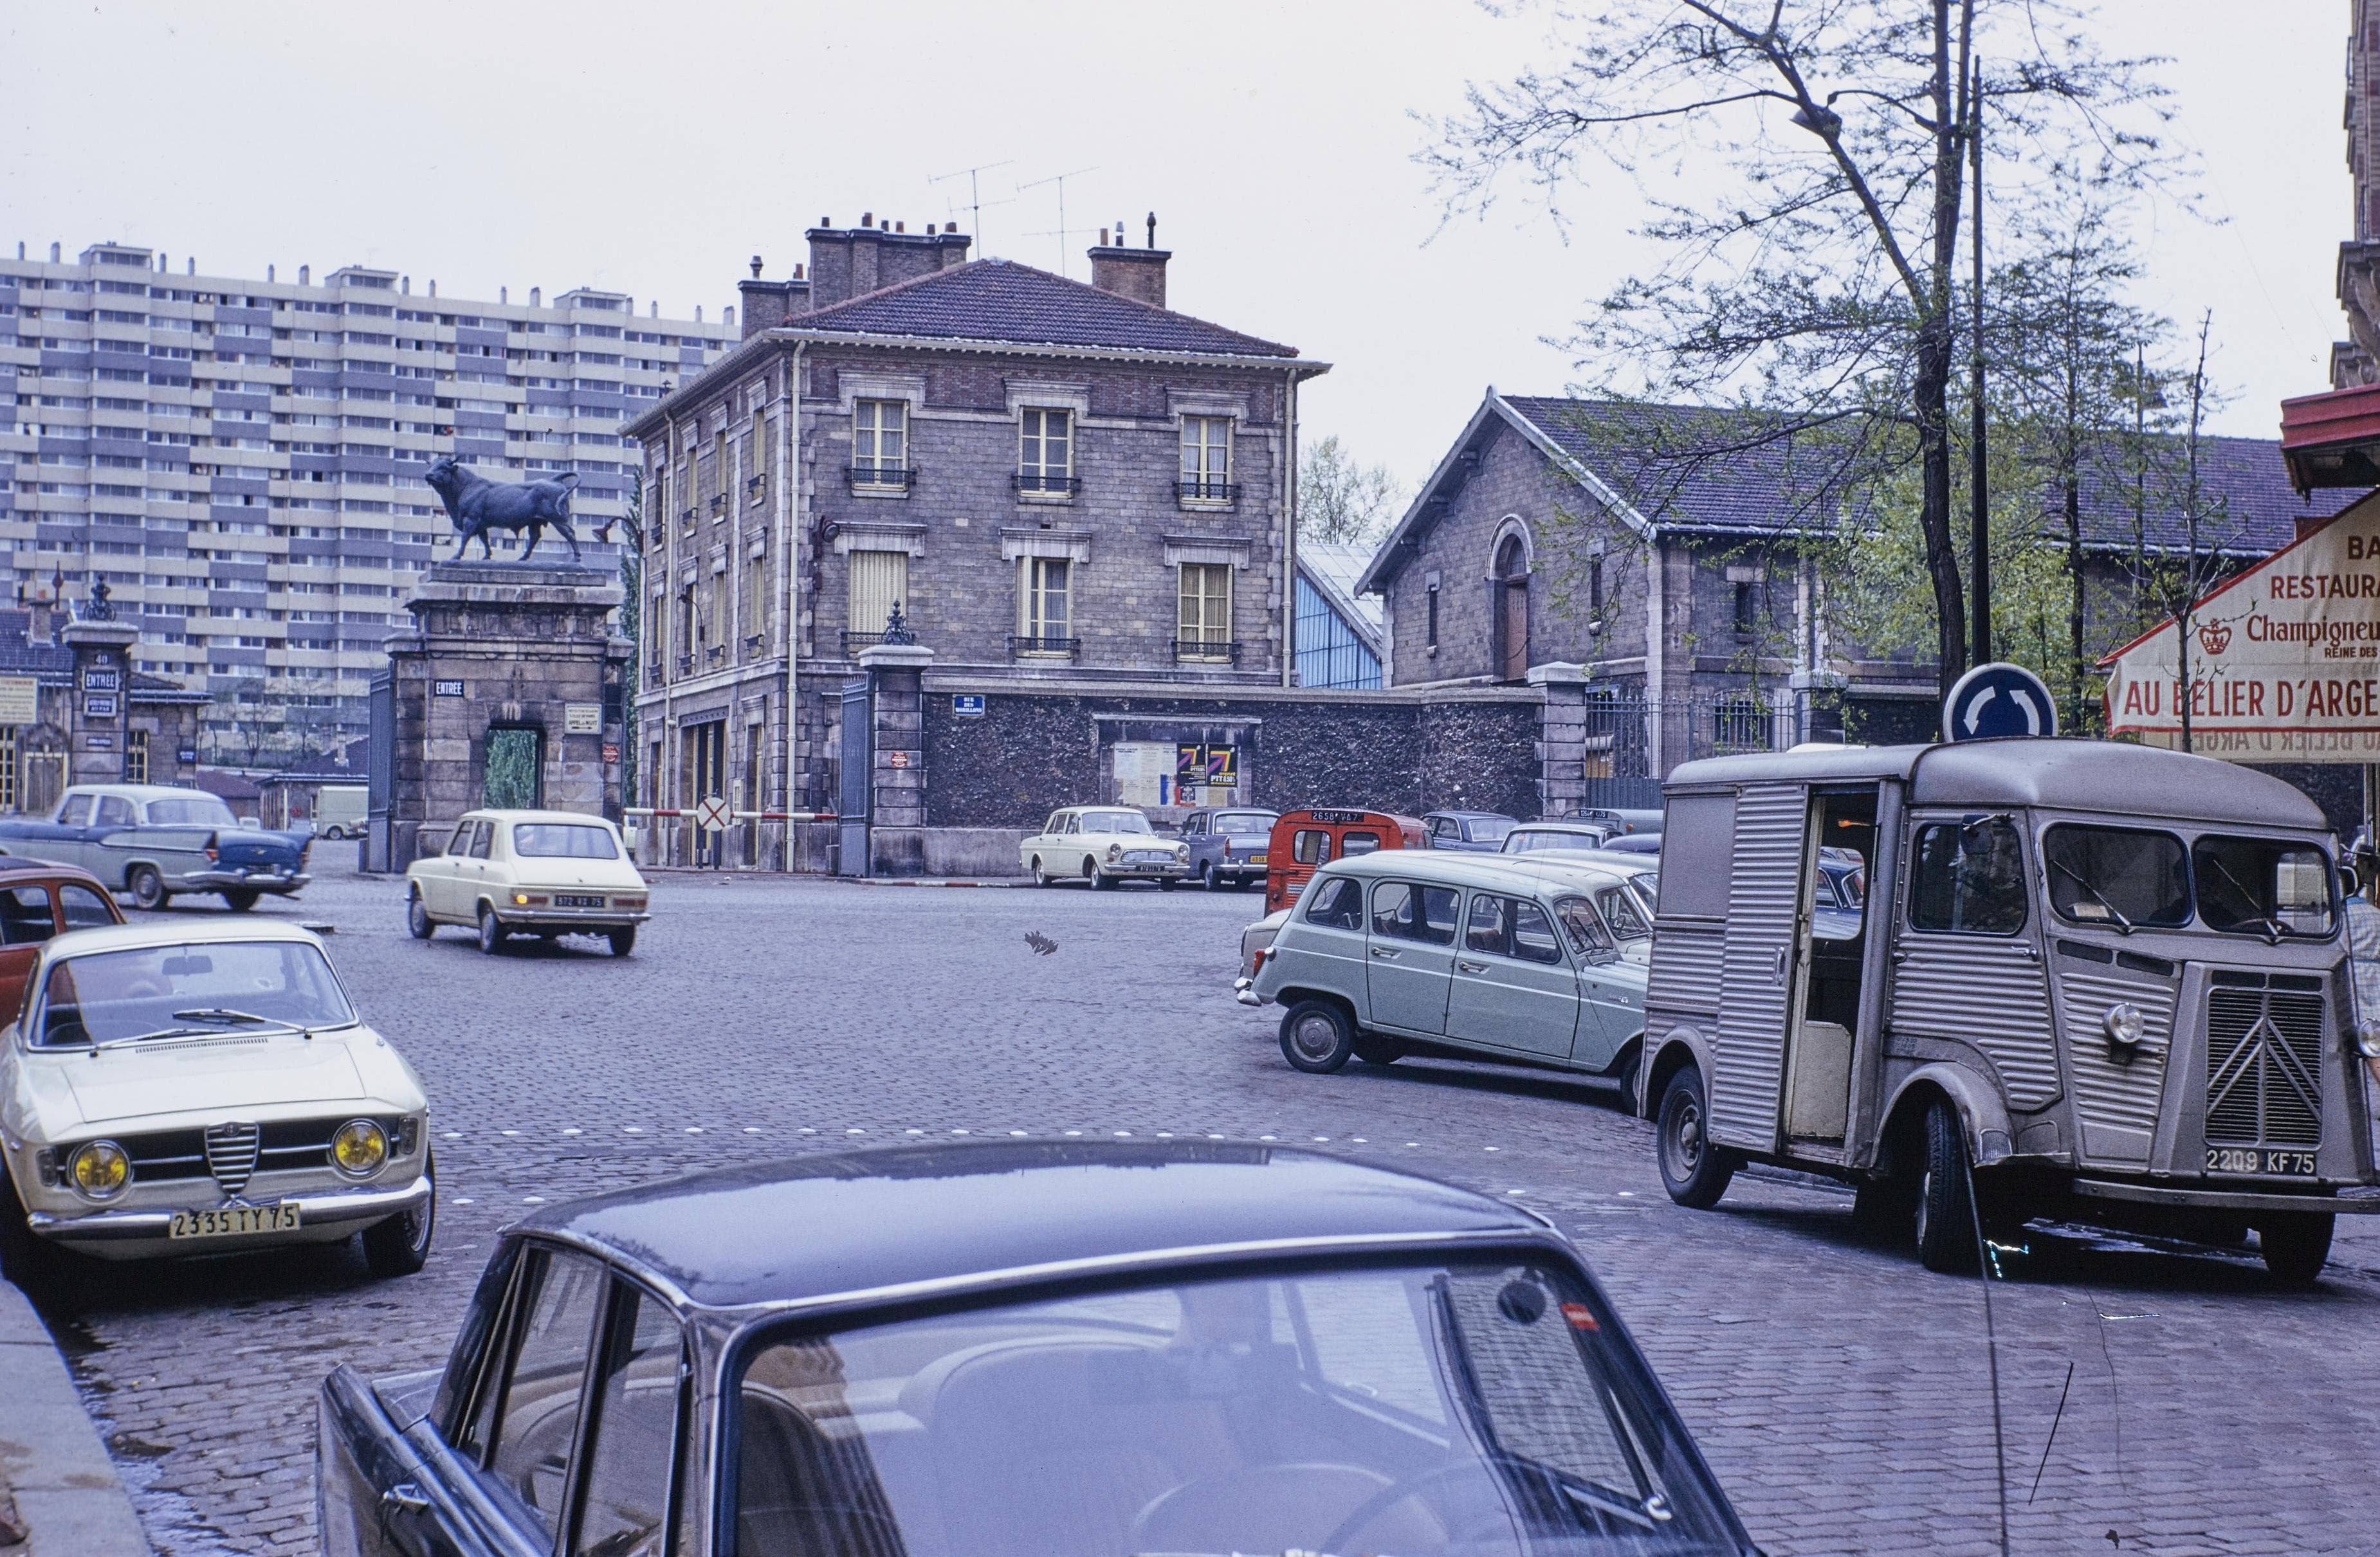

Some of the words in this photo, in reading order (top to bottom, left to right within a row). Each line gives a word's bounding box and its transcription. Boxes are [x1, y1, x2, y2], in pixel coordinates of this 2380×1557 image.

[2271, 574, 2380, 599] RESTAUR
[95, 654, 108, 664] 40
[2325, 648, 2356, 658] REINE
[2360, 647, 2378, 657] DES
[2125, 680, 2159, 716] AU
[1312, 812, 1335, 820] 2658
[2207, 1149, 2258, 1171] 2209
[2267, 1151, 2290, 1172] KF
[2292, 1153, 2314, 1174] 75
[175, 1211, 229, 1236] 2335
[237, 1208, 262, 1232] TY
[270, 1206, 295, 1230] 75
